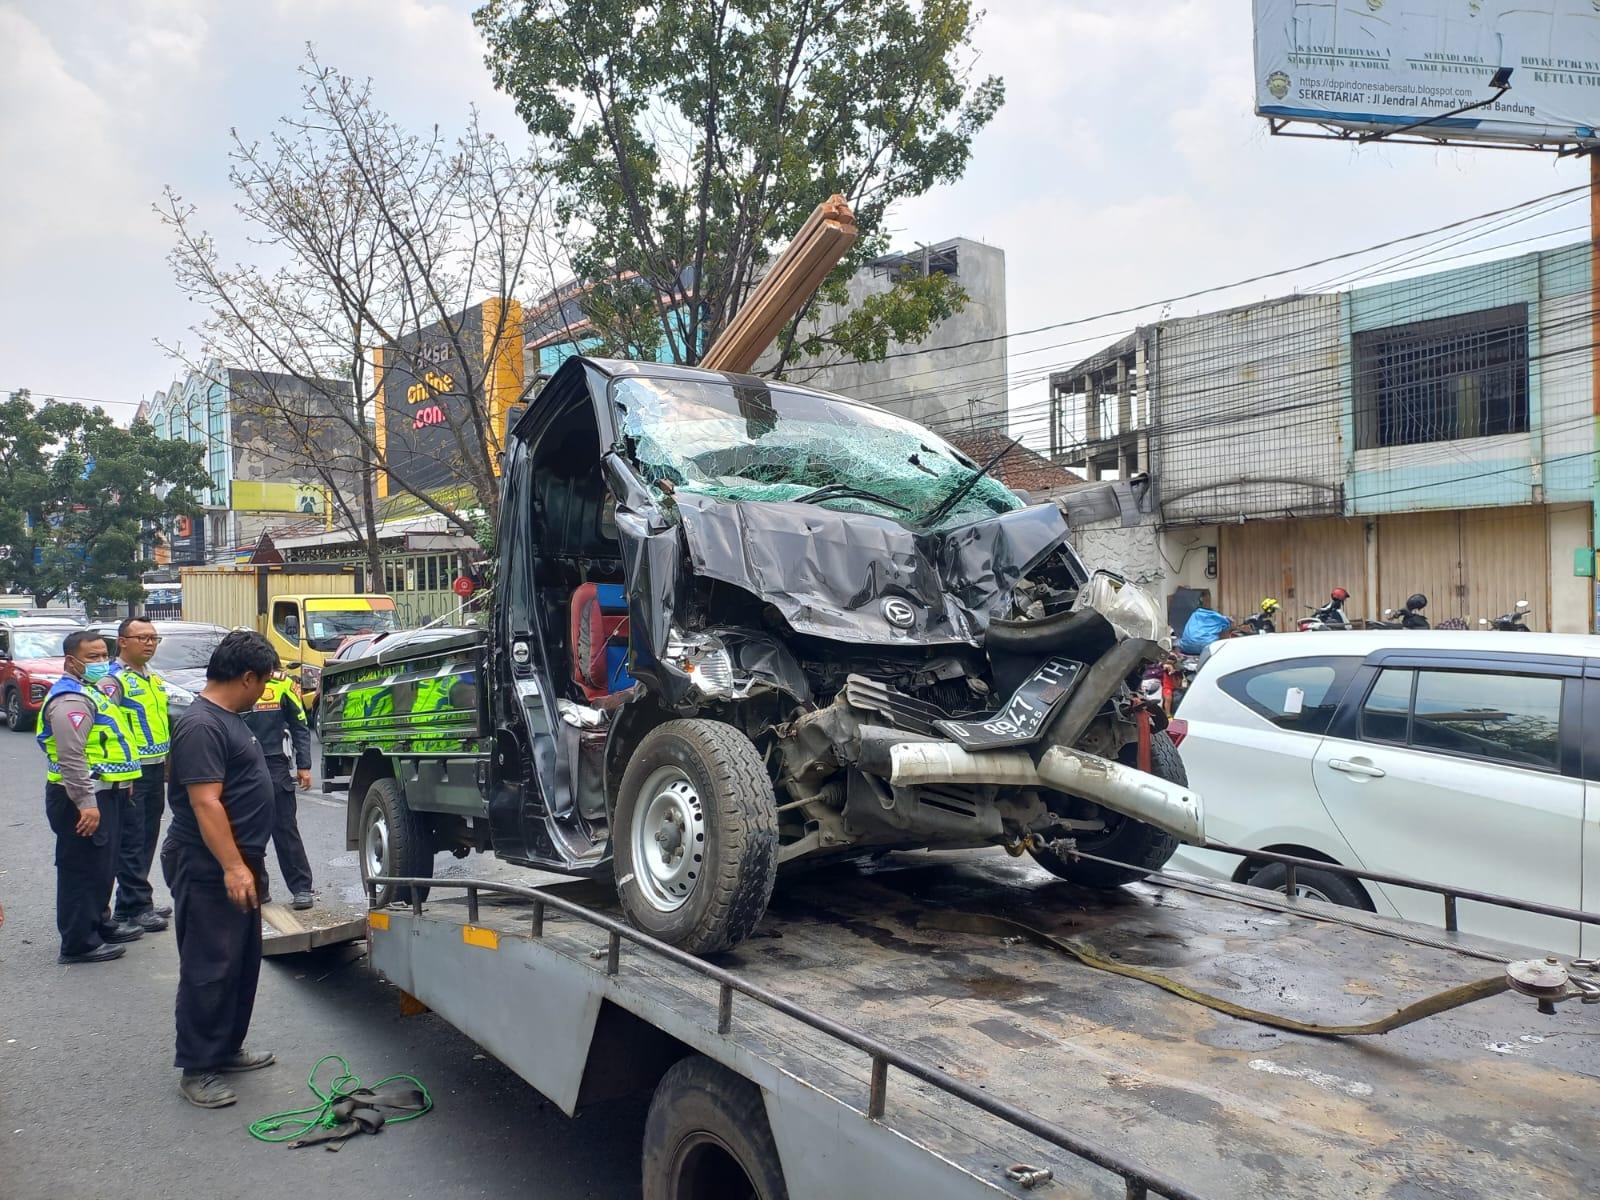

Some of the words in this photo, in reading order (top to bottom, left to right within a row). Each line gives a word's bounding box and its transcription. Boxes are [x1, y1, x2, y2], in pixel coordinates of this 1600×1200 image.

[1288, 56, 1345, 67] SEKRETARIS
[1349, 60, 1390, 70] JENDRAL
[1441, 64, 1469, 74] KETUA
[1533, 71, 1574, 84] KETUA
[1299, 77, 1472, 97] https://dppindonesiabersatu.blogspot.com
[1298, 88, 1365, 103] SEKRETARIAT
[1382, 95, 1419, 107] Jendral
[1421, 96, 1456, 109] Ahmad
[1495, 101, 1536, 116] Bandung
[983, 695, 1034, 736] 8947
[1033, 660, 1065, 686] TH
